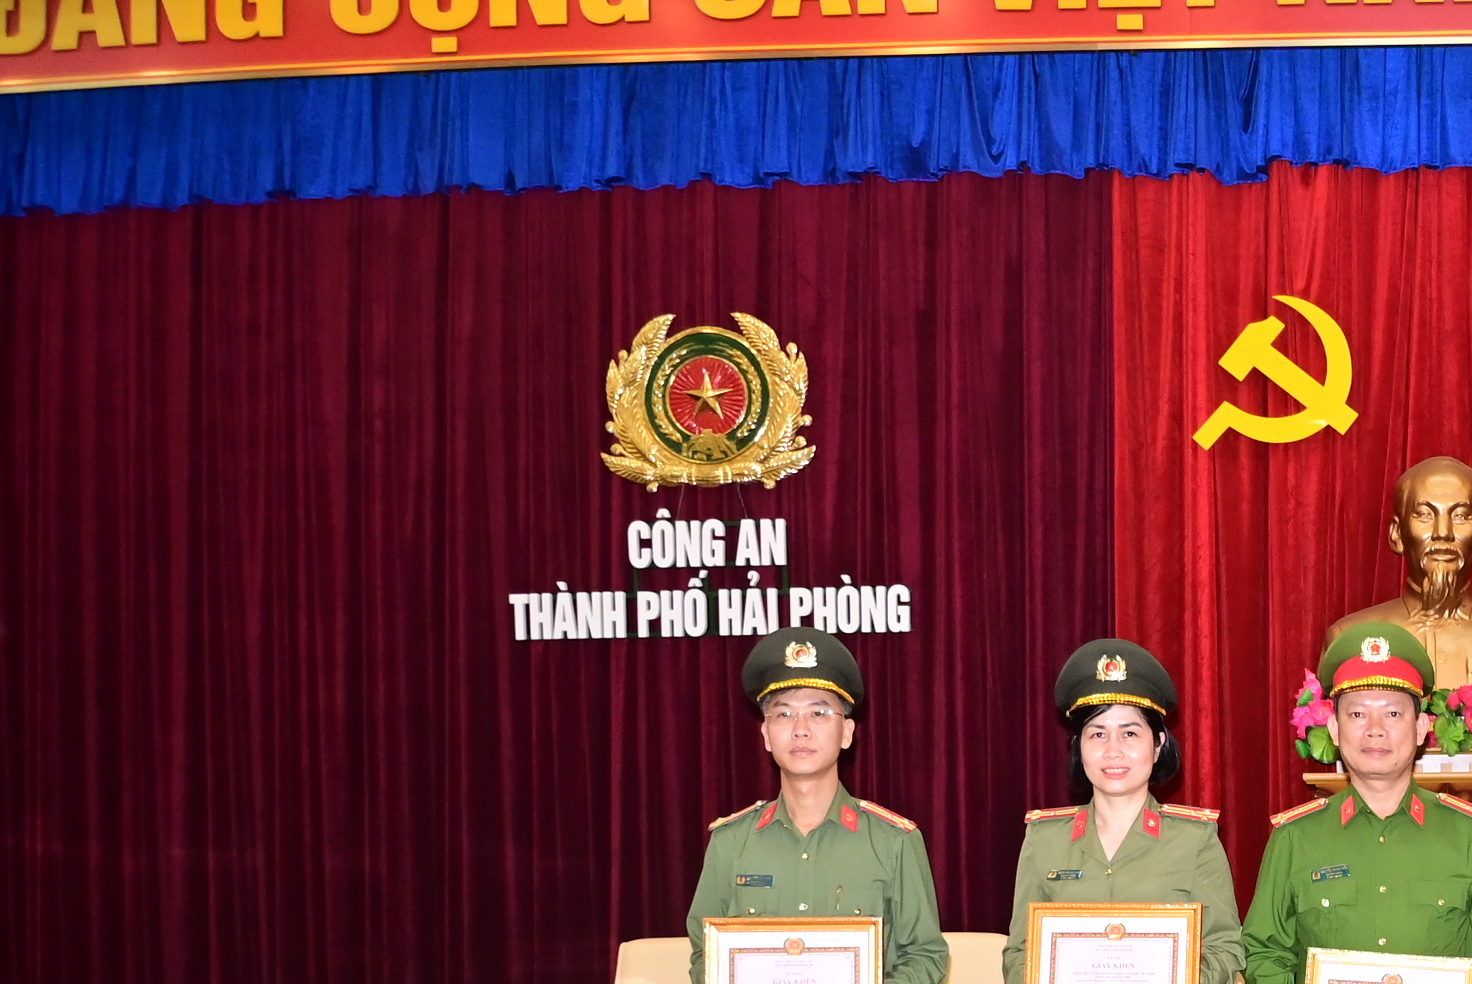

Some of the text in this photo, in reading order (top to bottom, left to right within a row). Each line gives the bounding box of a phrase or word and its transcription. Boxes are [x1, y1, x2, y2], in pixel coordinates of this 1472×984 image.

[627, 508, 787, 569] CÔNG AN
[508, 569, 911, 641] THÀNH PHỐ HẢI PHÒNG
